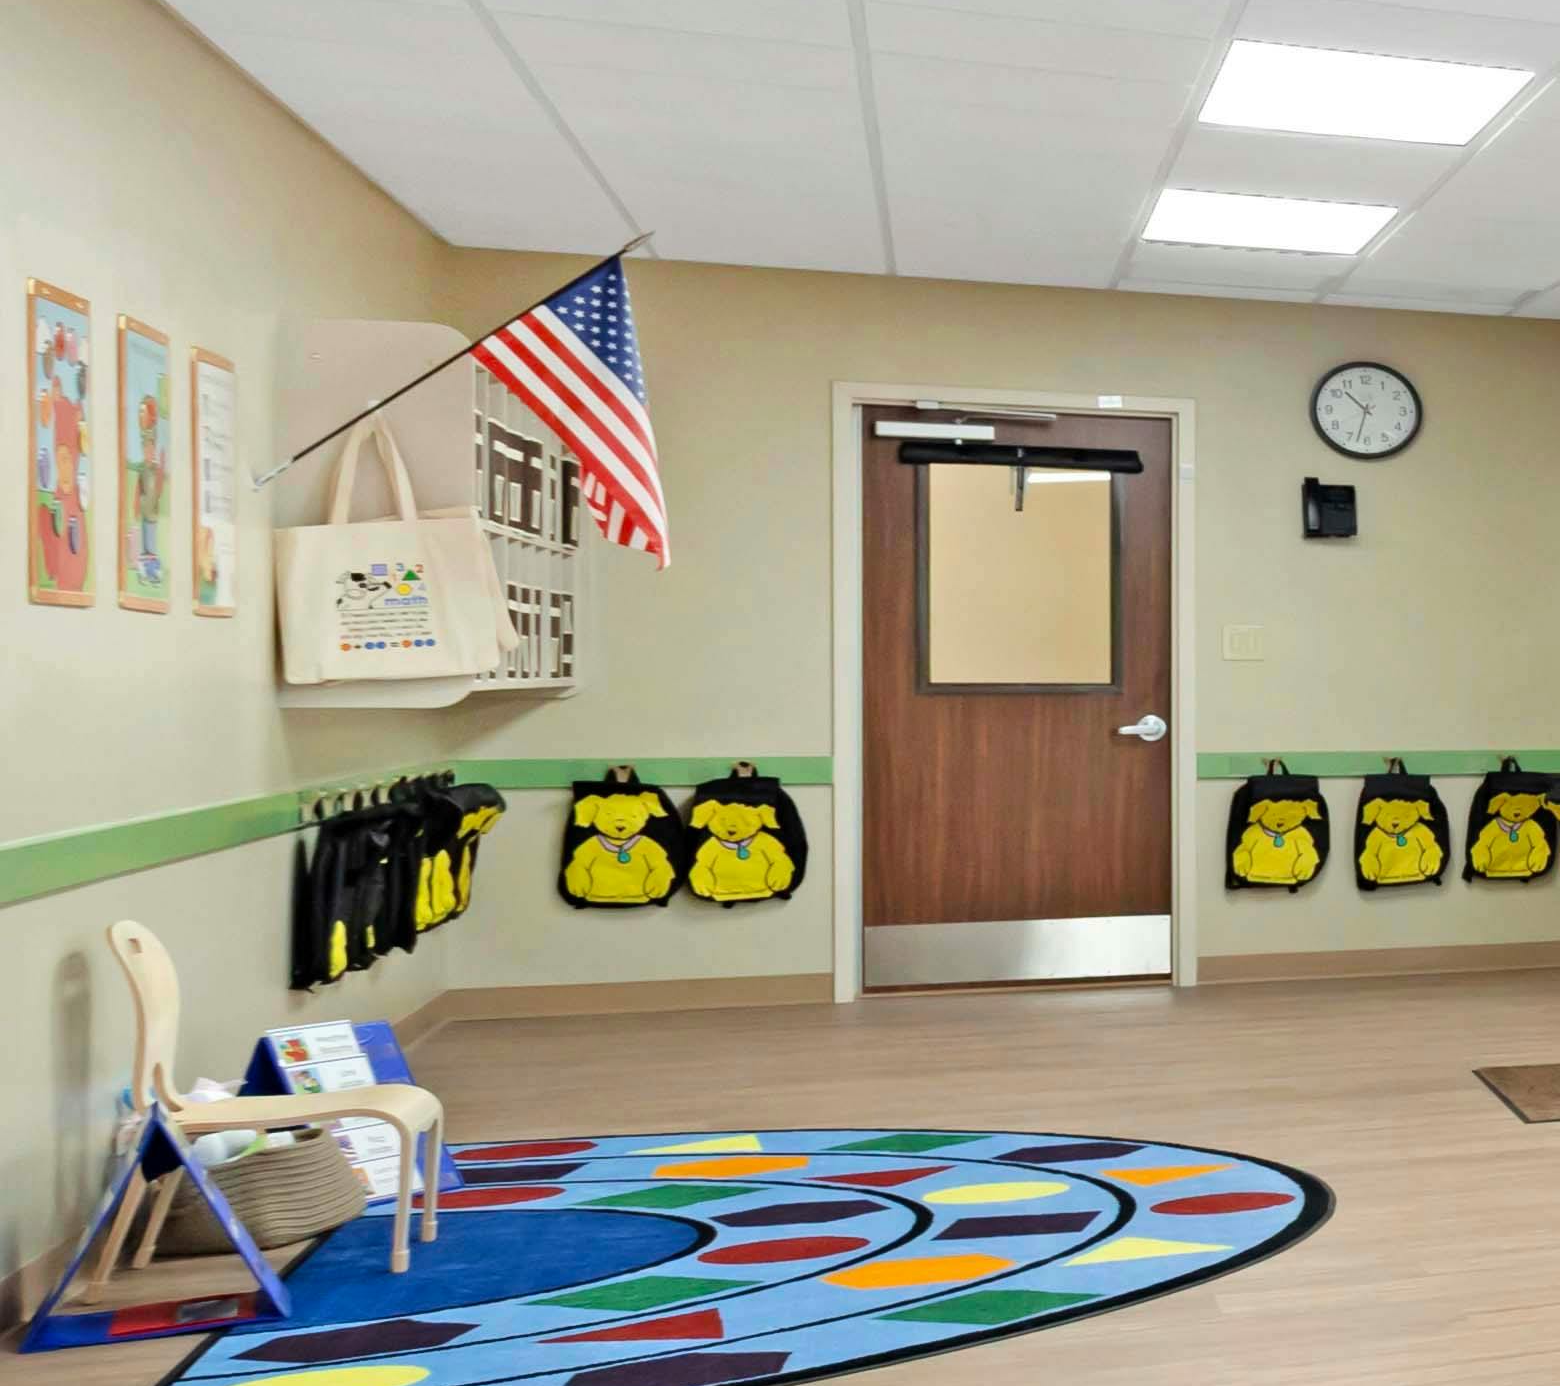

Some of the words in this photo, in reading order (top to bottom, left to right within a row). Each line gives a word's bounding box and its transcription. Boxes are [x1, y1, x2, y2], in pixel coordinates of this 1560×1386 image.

[1342, 379, 1352, 389] 11
[1359, 375, 1372, 385] 12
[1380, 381, 1385, 390] 1
[1330, 389, 1343, 398] 10
[1392, 391, 1401, 401] 2
[1324, 405, 1333, 414] 9
[1399, 406, 1407, 416] 3
[1331, 420, 1340, 430] 8
[1394, 422, 1402, 431] 4
[1346, 432, 1354, 441] 7
[1381, 433, 1389, 442] 5
[1363, 437, 1371, 446] 6
